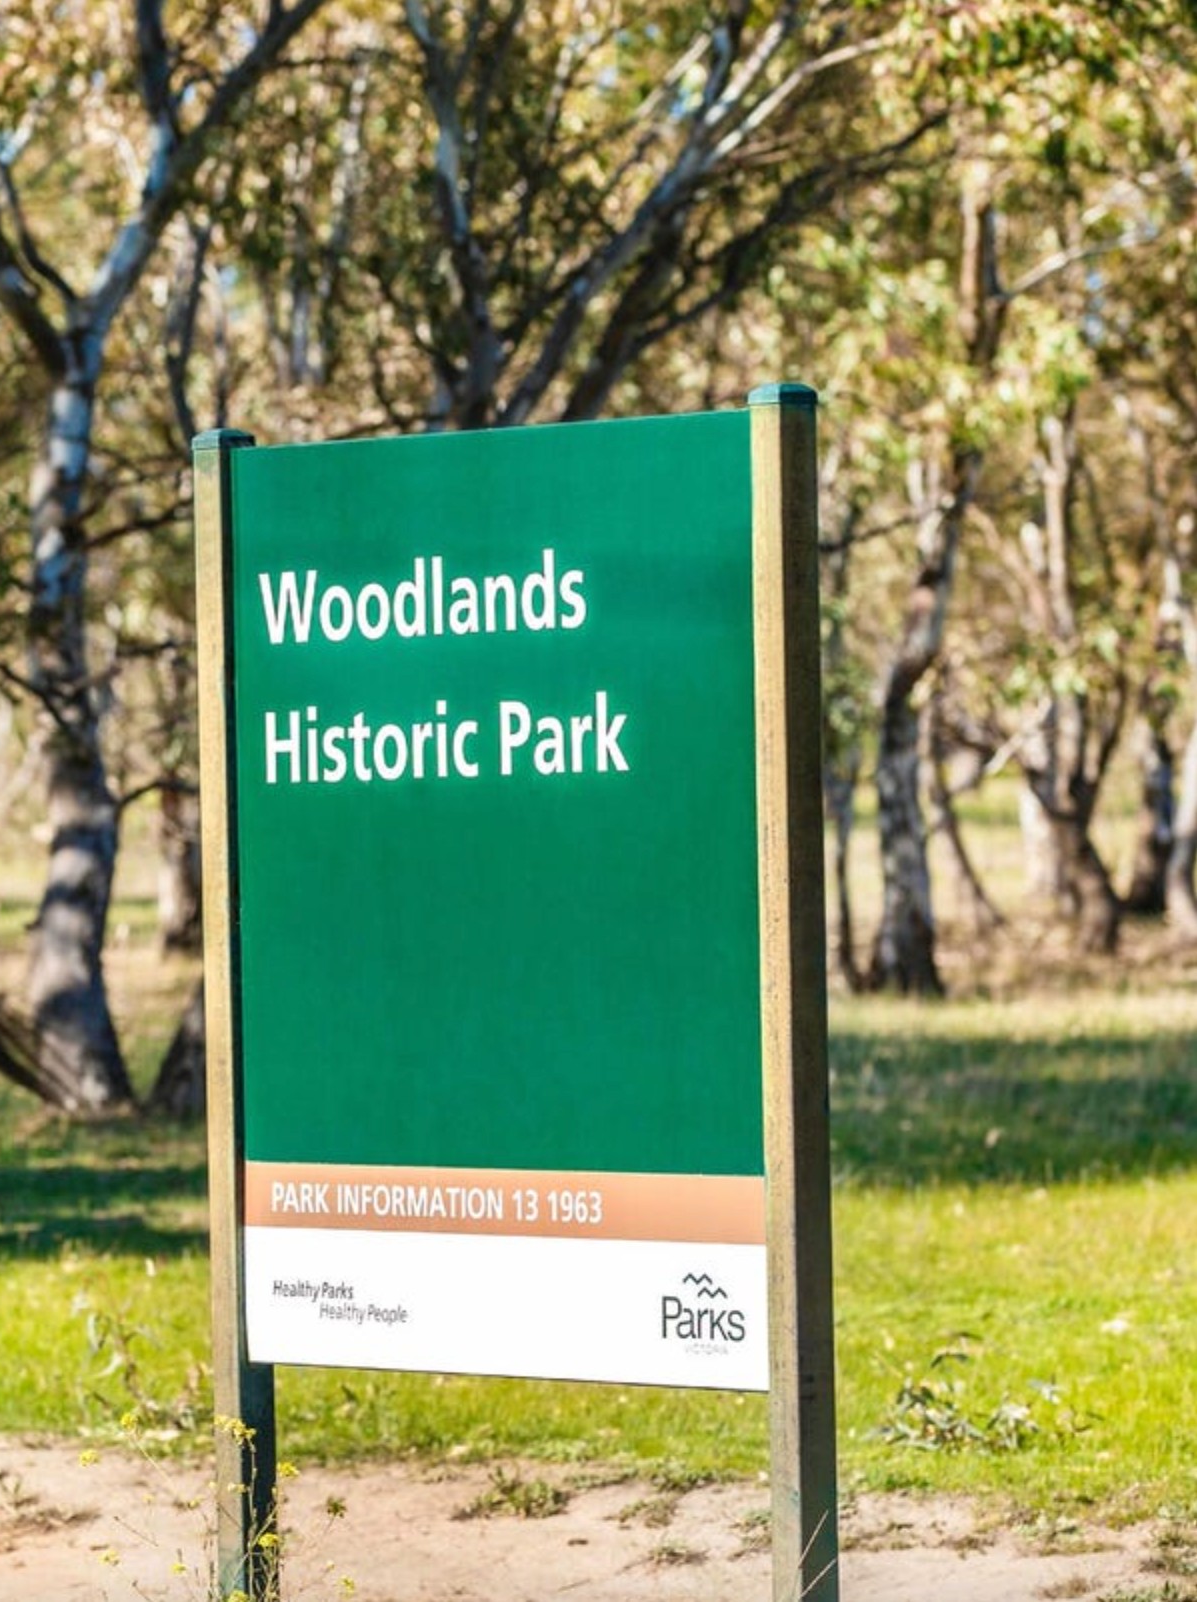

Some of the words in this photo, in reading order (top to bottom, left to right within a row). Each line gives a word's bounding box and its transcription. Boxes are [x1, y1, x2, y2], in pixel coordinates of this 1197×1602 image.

[259, 548, 587, 645] Woodlands
[265, 699, 479, 784] Historic
[499, 690, 629, 776] Park
[271, 1181, 330, 1213] PARK
[337, 1184, 504, 1220] INFORMATION
[512, 1190, 539, 1222] 13
[547, 1191, 603, 1224] 1963
[273, 1280, 321, 1302] Healthy
[321, 1281, 354, 1300] Parks
[319, 1302, 366, 1325] Healthy
[368, 1303, 408, 1325] People
[661, 1296, 746, 1343] Parks
